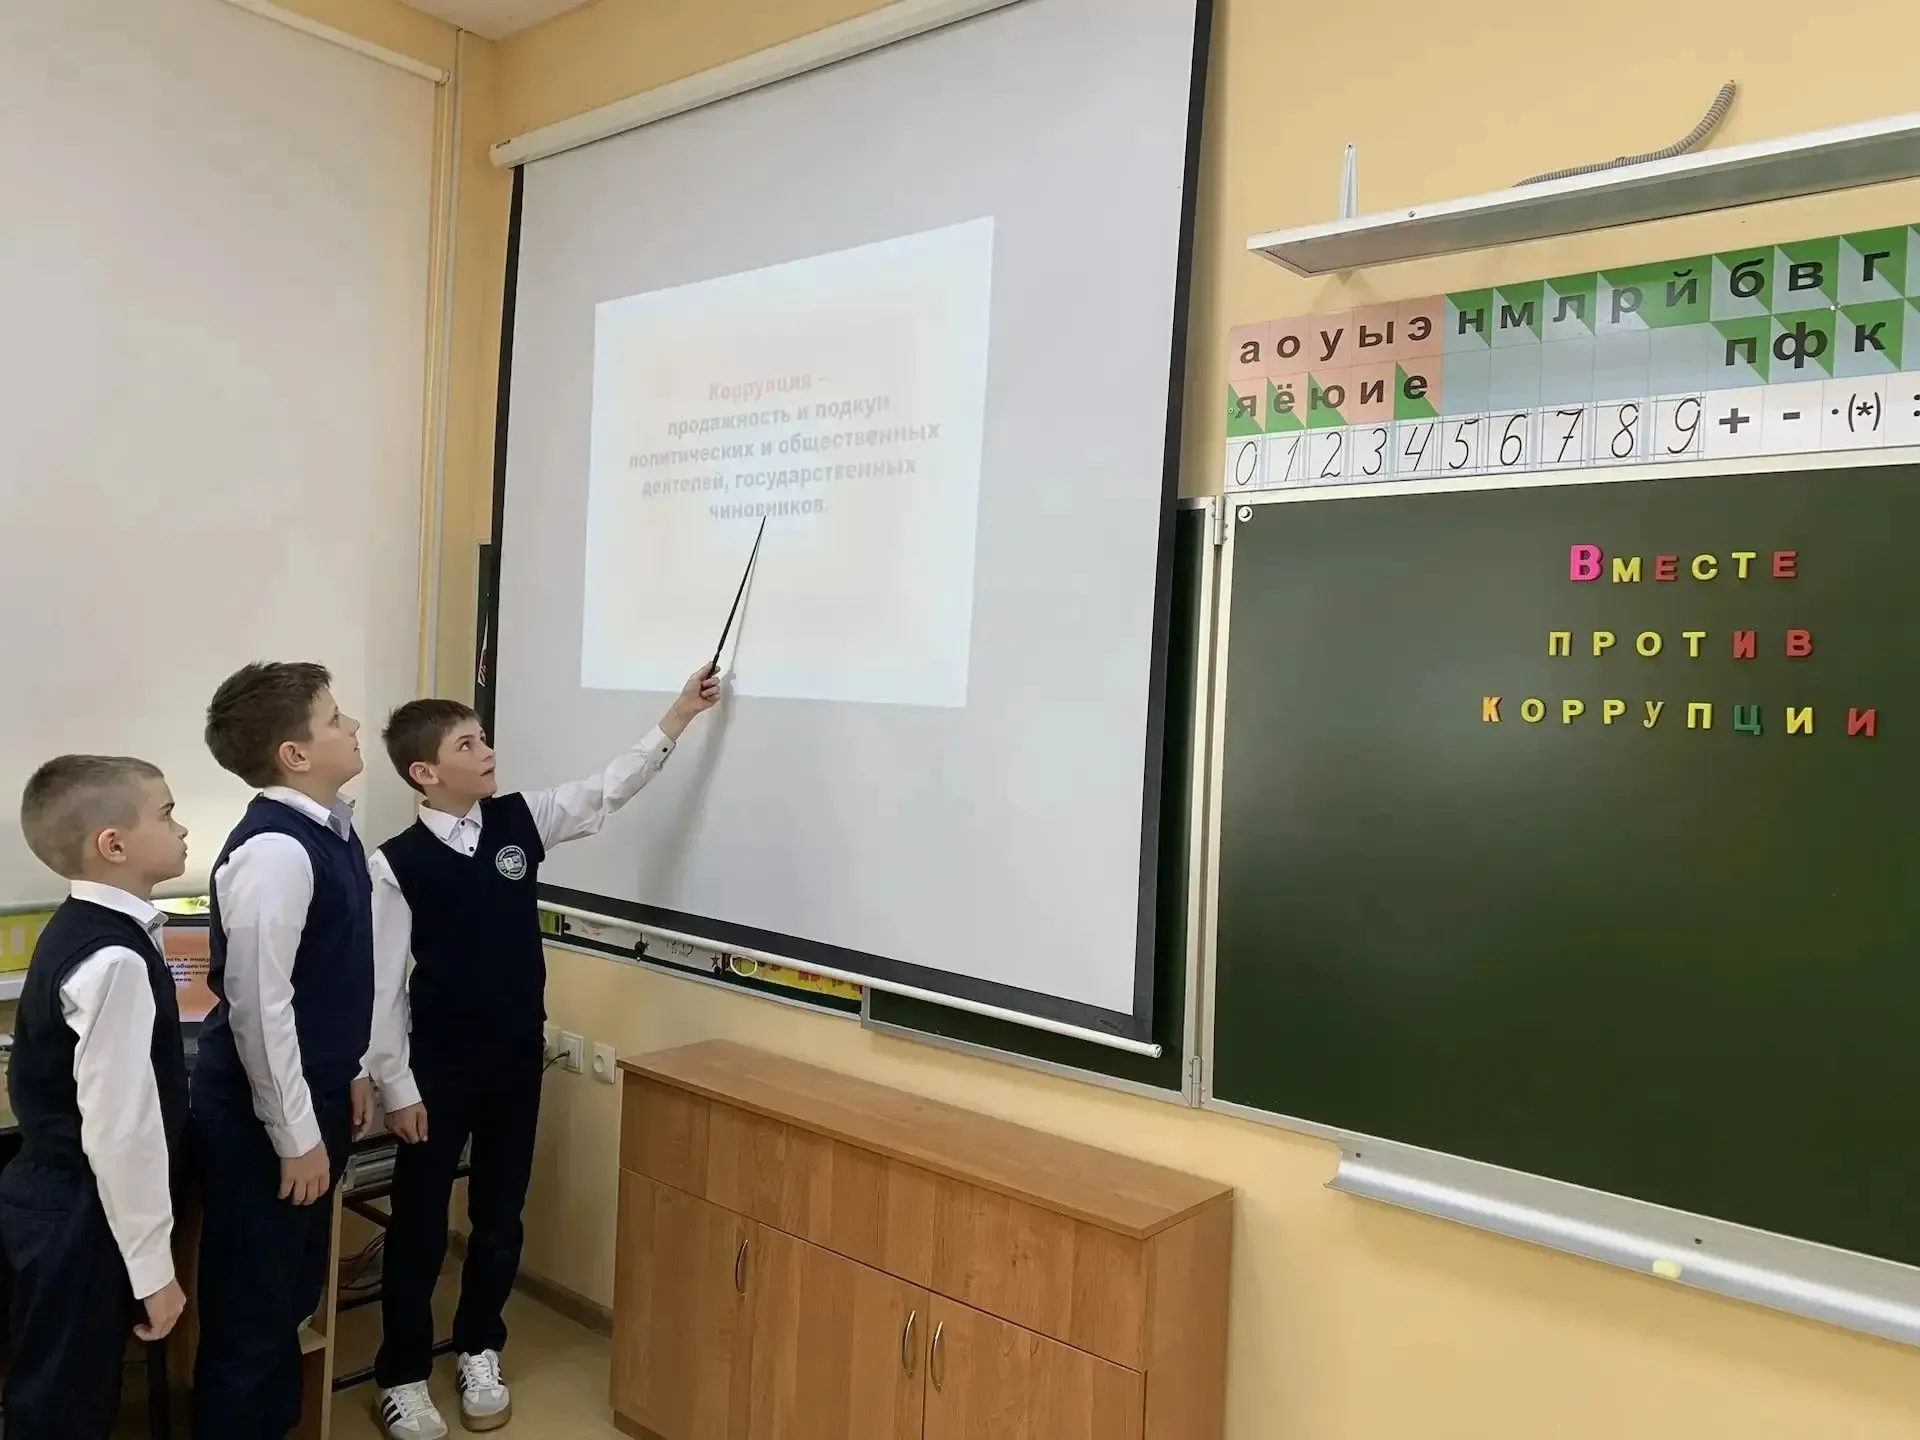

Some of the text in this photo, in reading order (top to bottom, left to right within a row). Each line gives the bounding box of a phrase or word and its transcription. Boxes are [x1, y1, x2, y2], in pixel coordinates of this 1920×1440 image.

[1240, 251, 1890, 364] а о у ы э н м л р й б в г
[709, 373, 811, 404] Коррупция
[1235, 321, 1886, 419] я ё ю и е п ф к
[668, 395, 889, 439] продажность и подкуп
[629, 423, 940, 470] политических и общественных
[1236, 441, 1257, 485] 0
[1284, 436, 1301, 482] 1
[1320, 432, 1342, 478] 2
[1362, 428, 1387, 476] 3
[1404, 423, 1434, 471] 4
[1449, 419, 1479, 469] 5
[1500, 413, 1529, 466] 6
[1557, 409, 1583, 462] 7
[1611, 404, 1639, 458] 8
[1667, 398, 1700, 454] 9
[642, 458, 916, 498] деятелей, государственных
[709, 498, 828, 520] чиновников.
[1548, 629, 1813, 659] ПРОТИВ
